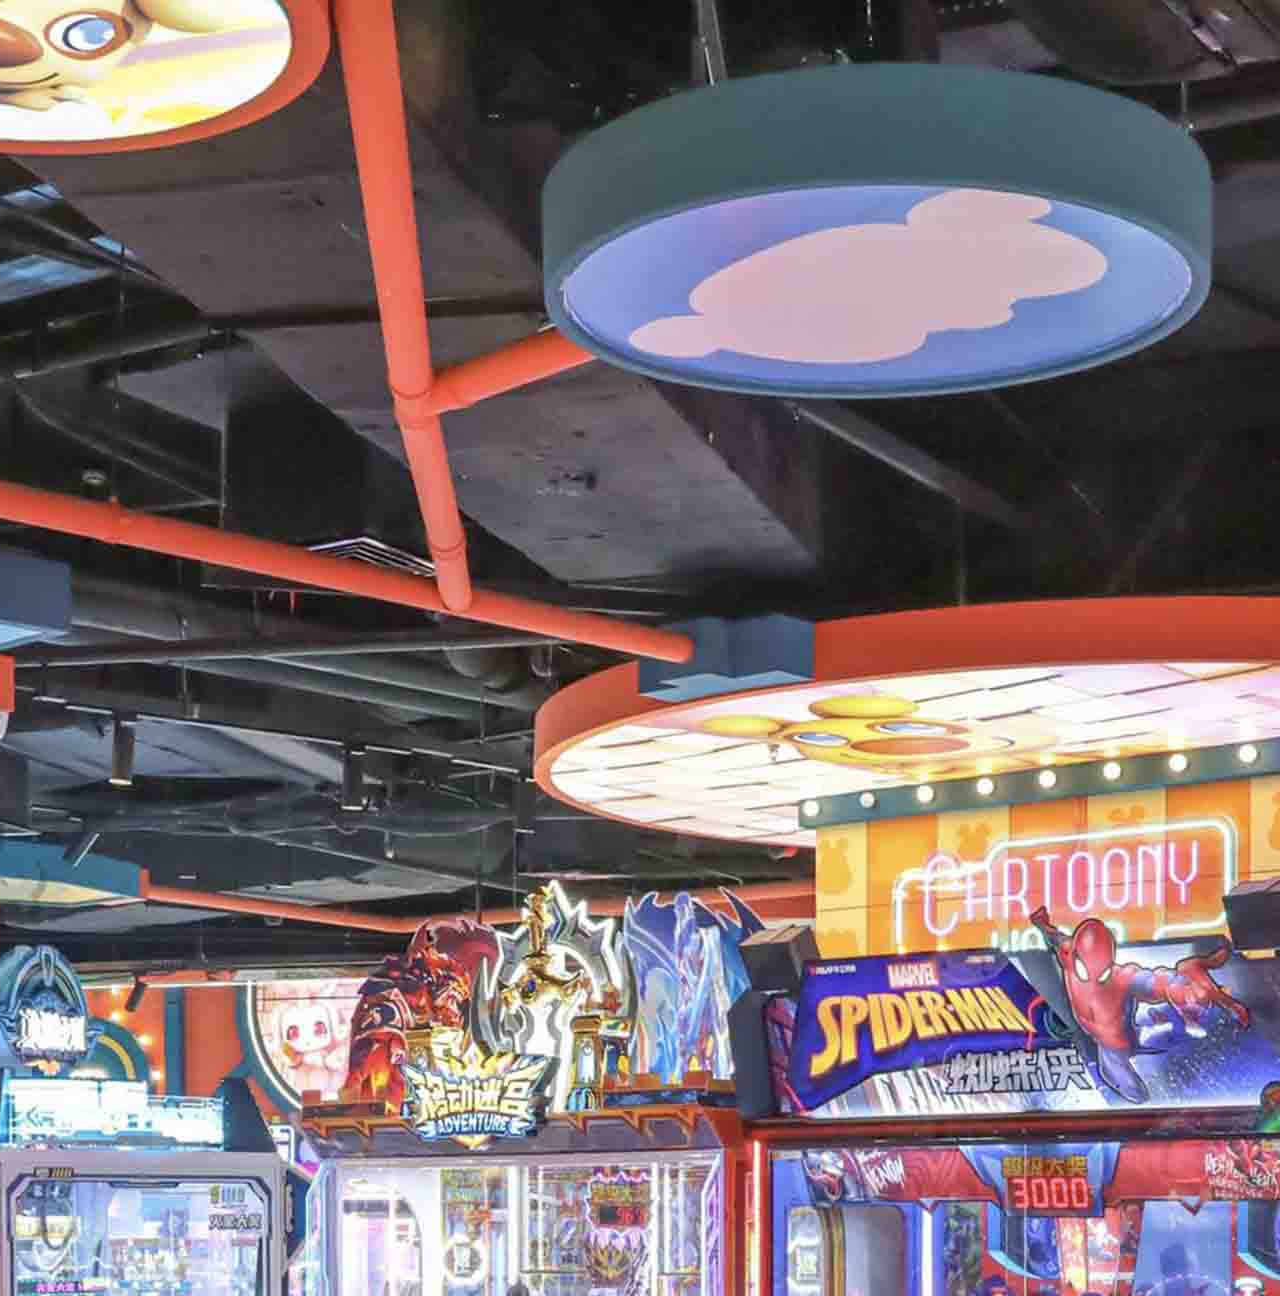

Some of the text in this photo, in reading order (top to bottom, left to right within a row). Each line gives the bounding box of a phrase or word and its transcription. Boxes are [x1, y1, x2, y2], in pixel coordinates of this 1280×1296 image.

[920, 840, 1200, 938] CARTOONY
[888, 964, 939, 987] MARVEL
[809, 986, 1037, 1078] SPIDER-MAN
[944, 1048, 1092, 1095] 蜘蛛侠
[438, 1114, 509, 1136] ADVENTURE
[1015, 1177, 1088, 1208] 3000
